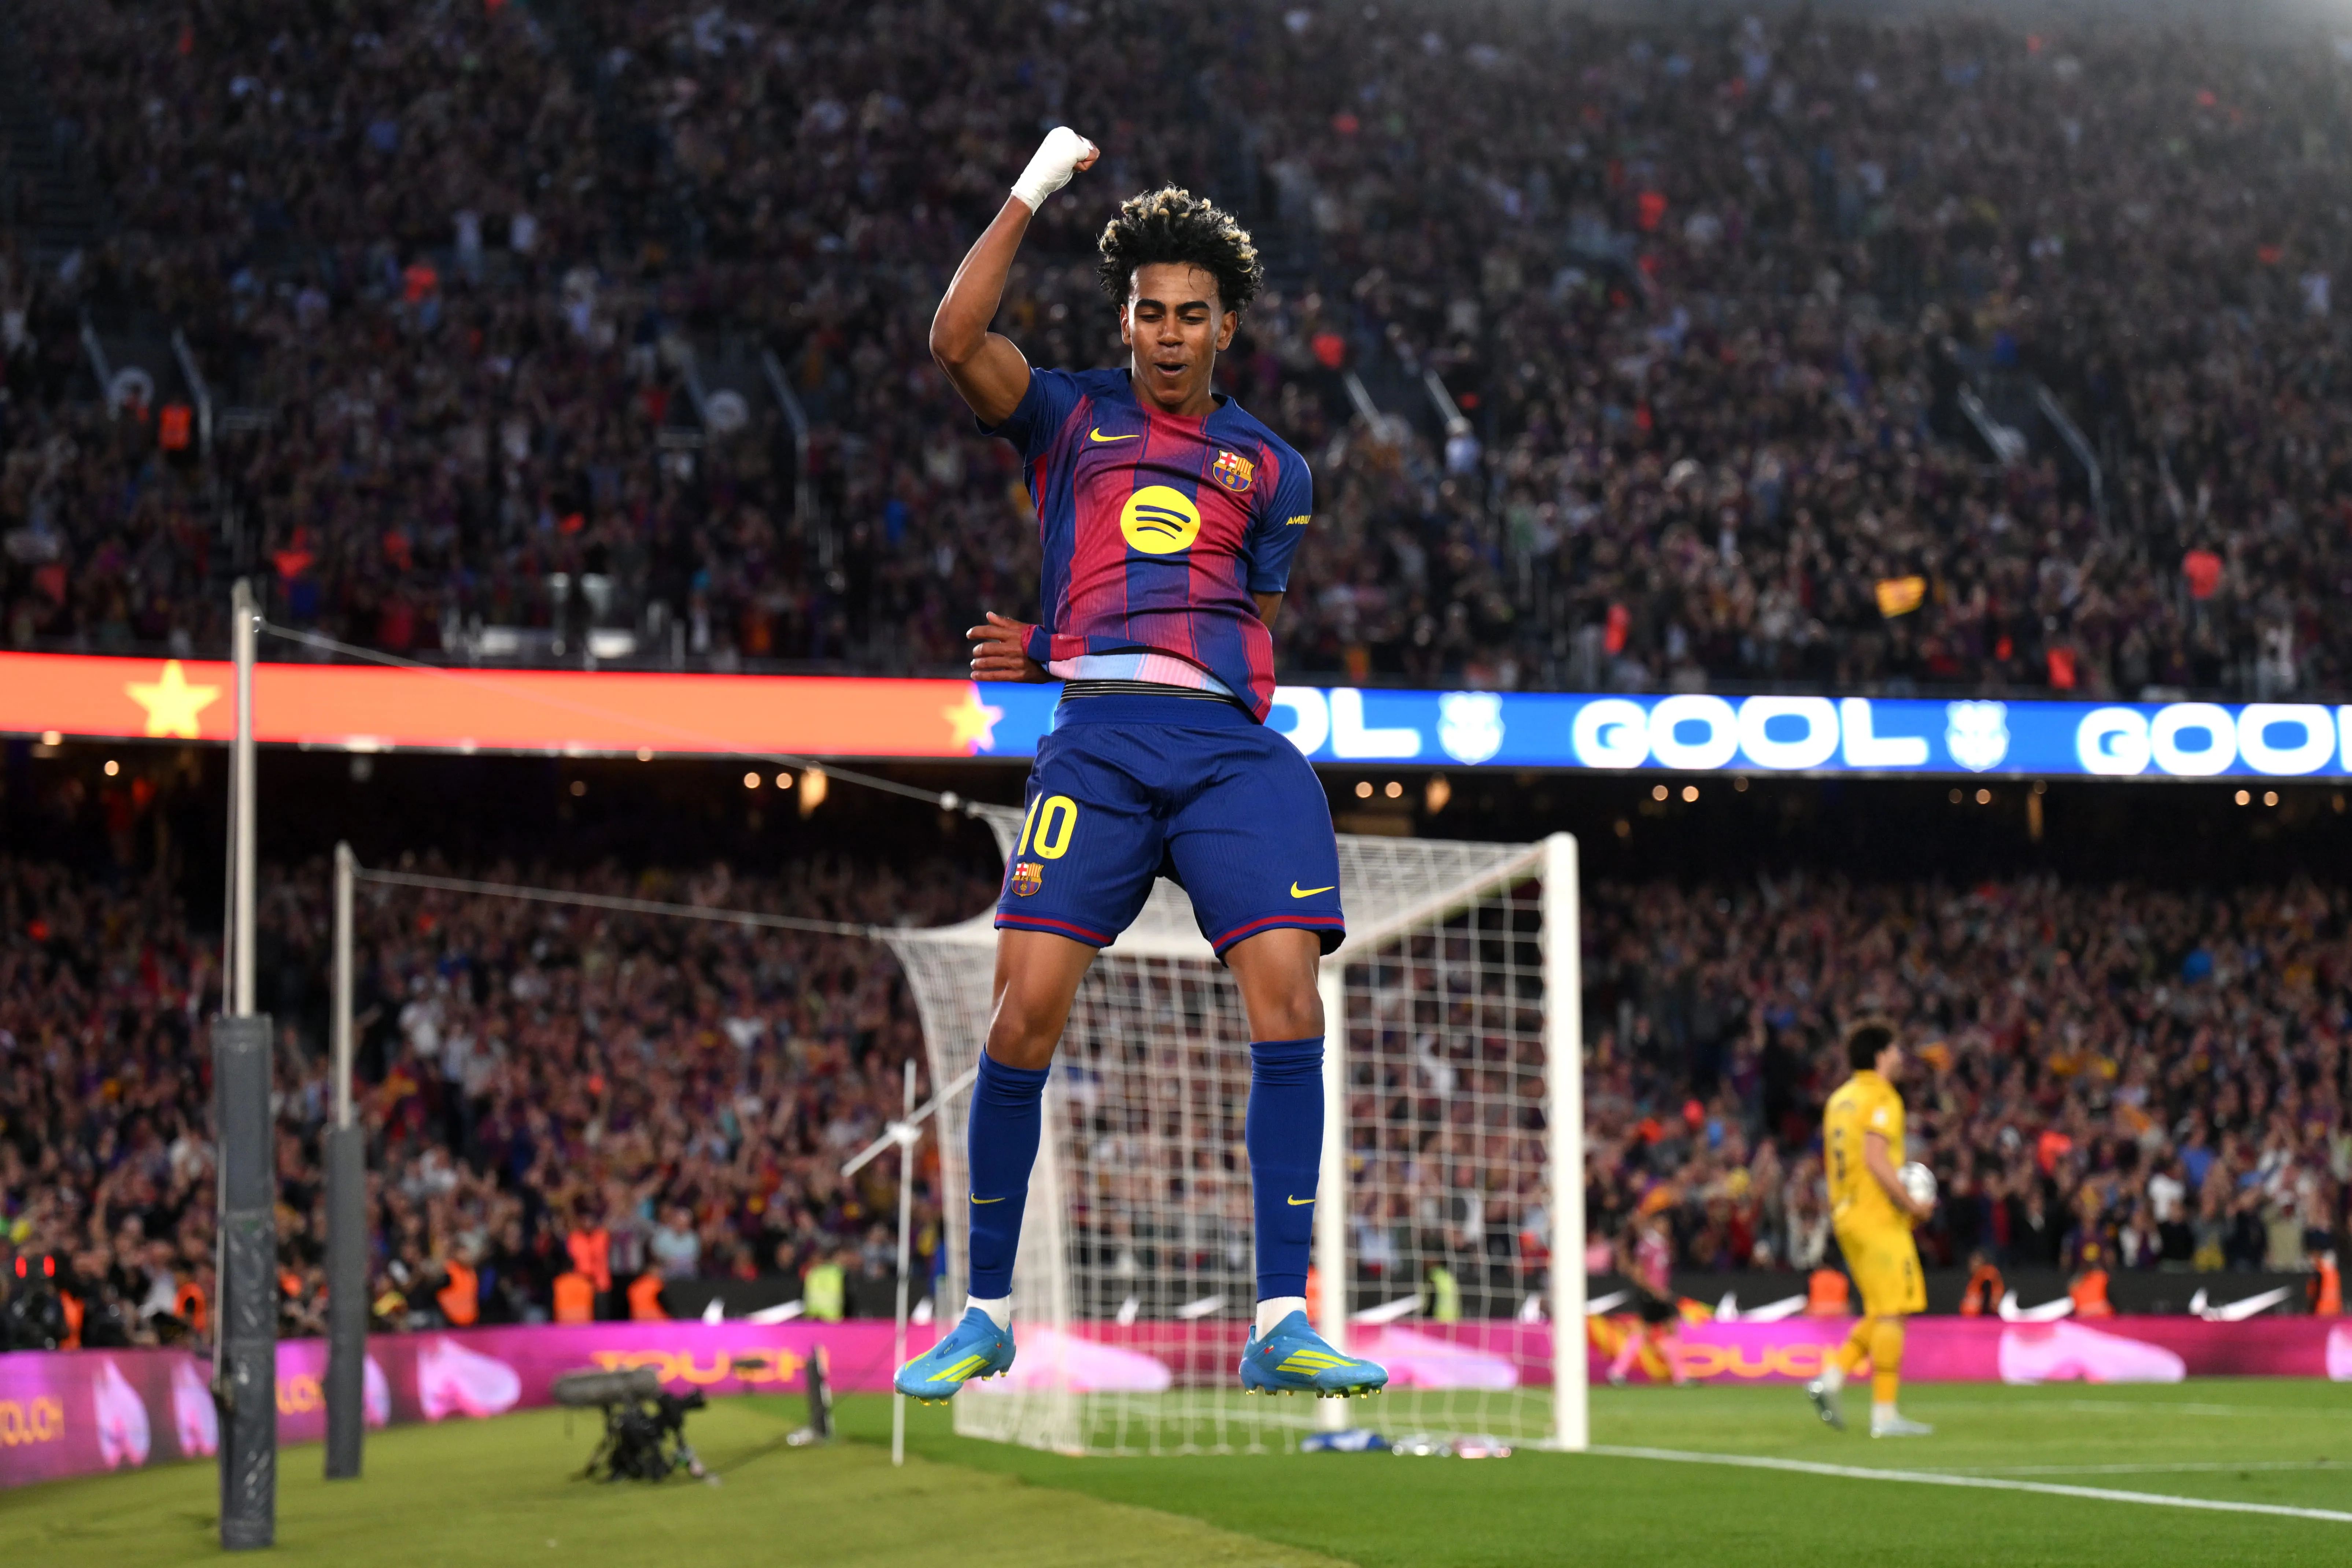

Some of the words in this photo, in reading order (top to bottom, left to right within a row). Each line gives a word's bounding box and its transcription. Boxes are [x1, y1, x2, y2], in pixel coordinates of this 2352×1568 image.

[1572, 694, 1929, 769] GOOL
[2076, 702, 2352, 776] GOO
[1017, 792, 1078, 859] 10
